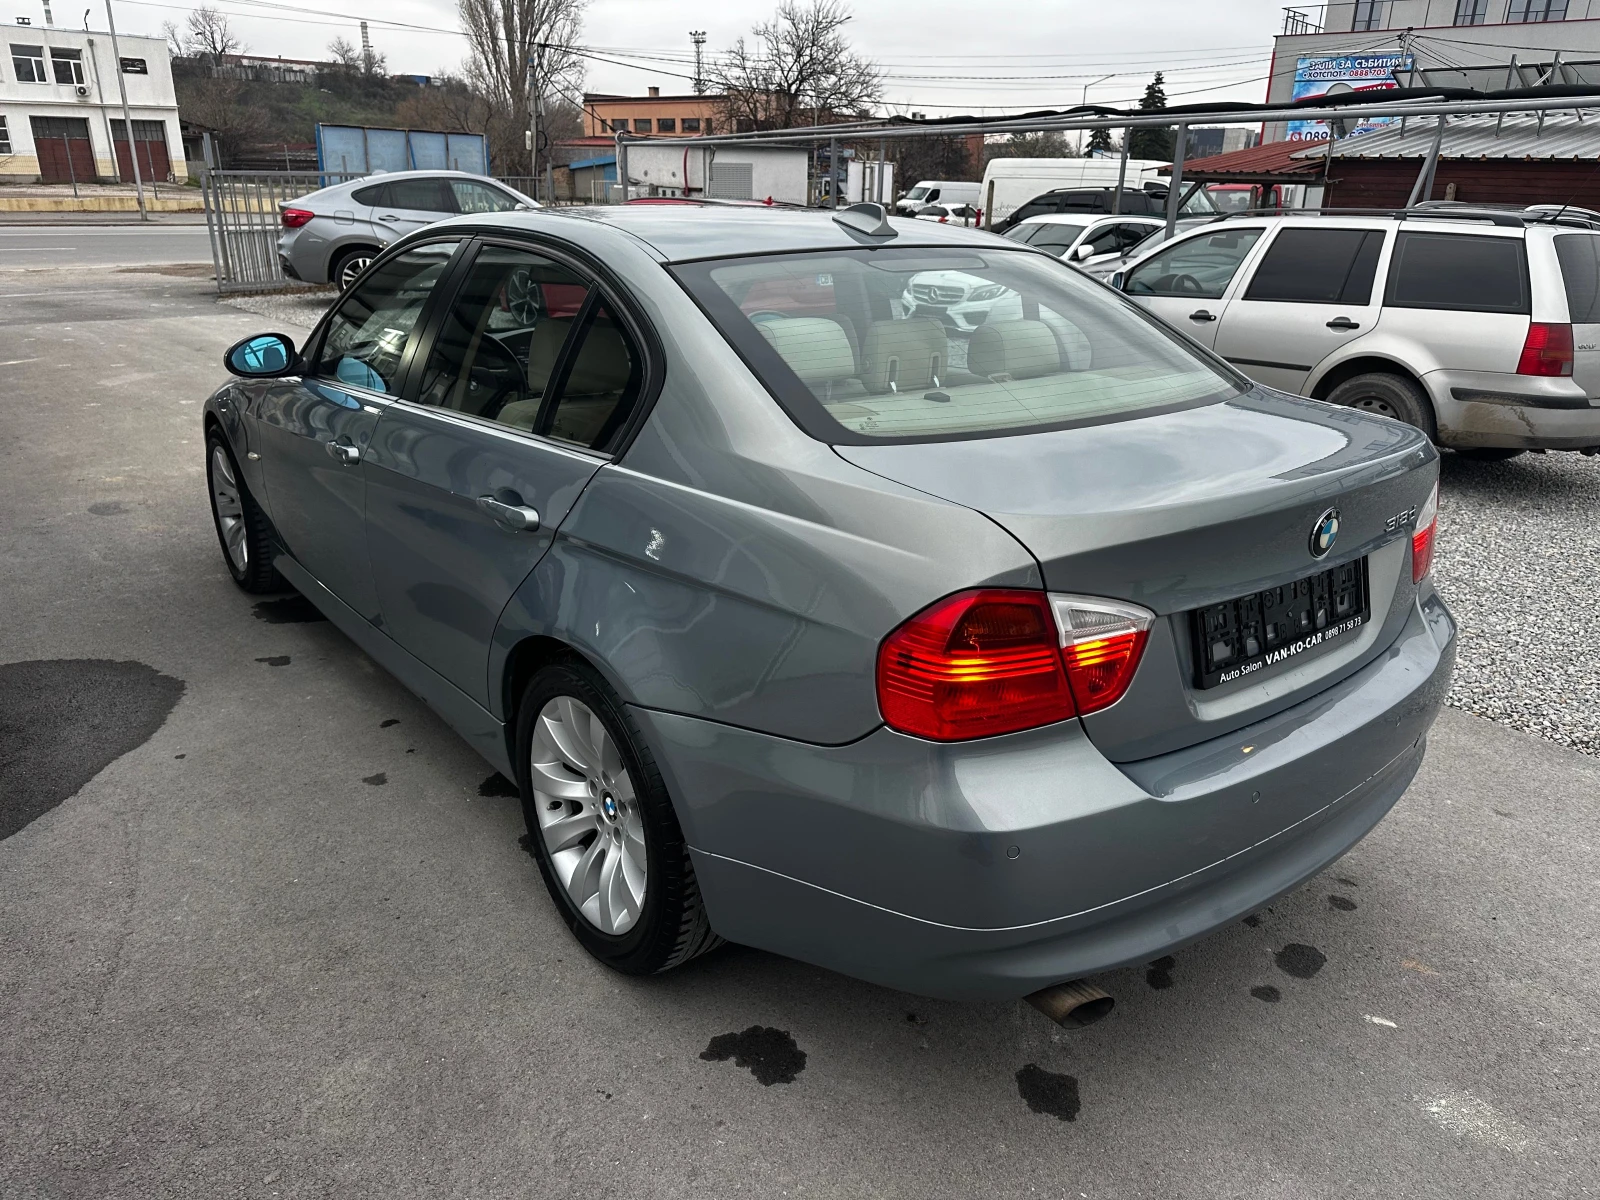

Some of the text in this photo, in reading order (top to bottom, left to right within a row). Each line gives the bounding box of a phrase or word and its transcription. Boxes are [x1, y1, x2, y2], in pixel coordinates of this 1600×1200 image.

[1309, 60, 1336, 70] ЗАЛИ
[1338, 60, 1352, 69] ЗА
[1349, 69, 1369, 77] 0888
[1219, 670, 1240, 683] Auto
[1241, 661, 1262, 675] Salon
[1265, 632, 1322, 665] VAN-KO-CAR
[1339, 623, 1346, 634] 71
[1354, 616, 1362, 627] 73
